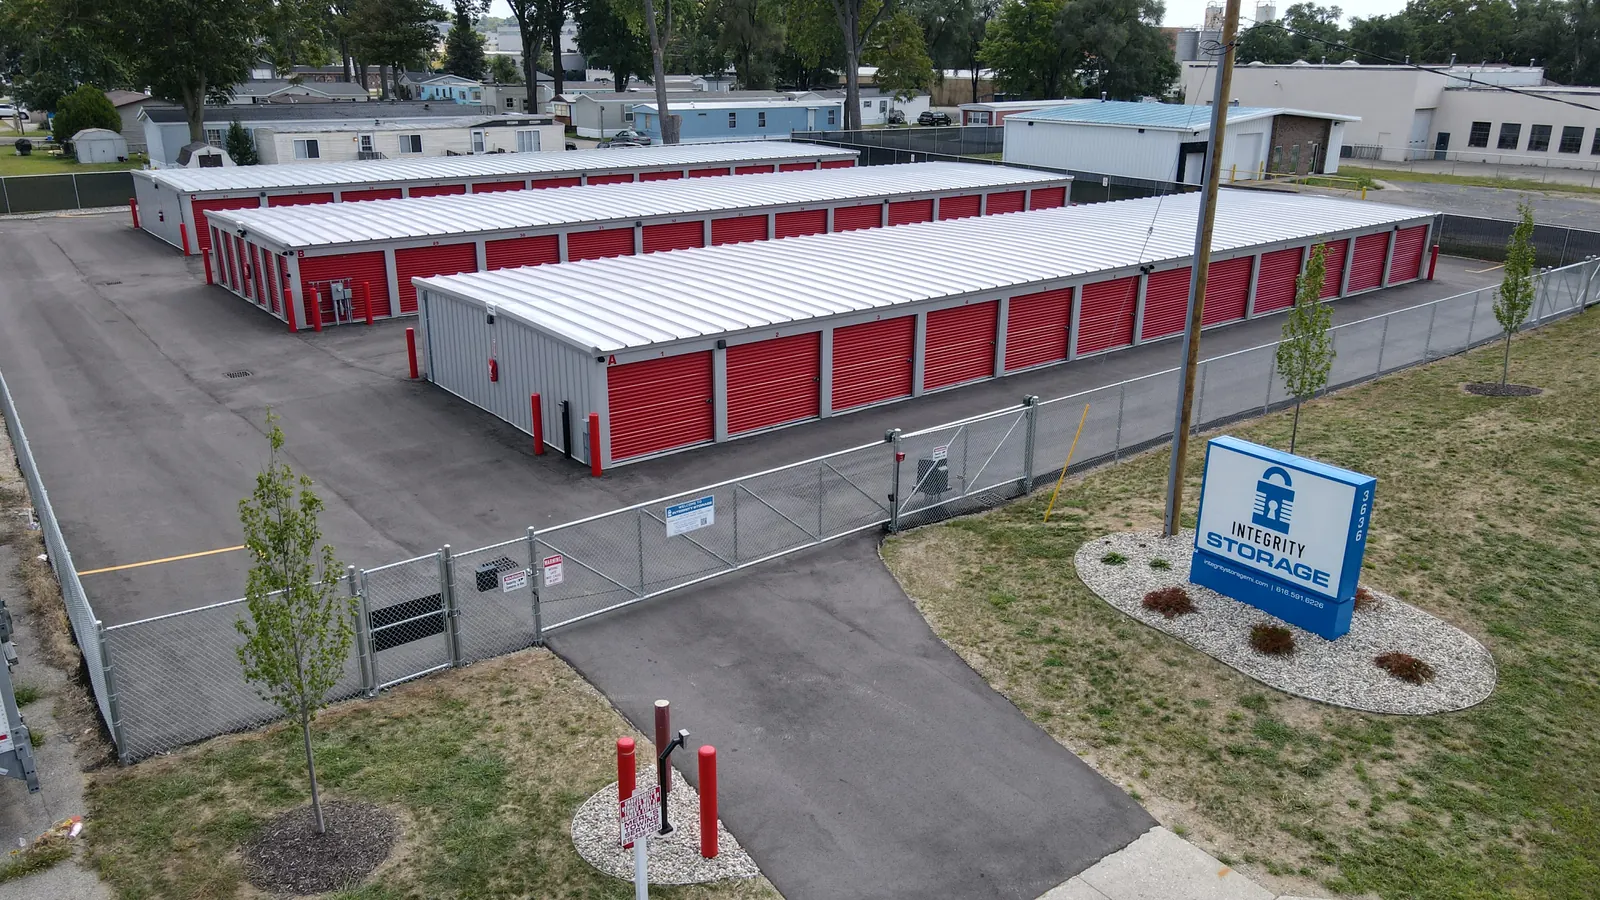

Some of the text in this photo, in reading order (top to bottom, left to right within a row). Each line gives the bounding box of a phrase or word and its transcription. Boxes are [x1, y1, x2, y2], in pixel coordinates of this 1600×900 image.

[297, 249, 305, 257] B
[607, 354, 617, 365] A
[1355, 489, 1369, 542] 3636
[1231, 521, 1306, 559] INTEGRITY
[544, 556, 562, 565] WARNING
[1206, 531, 1331, 588] STORAGE
[1203, 559, 1324, 609] integritystoragemi.com 616.591.6226
[624, 814, 659, 832] TOWING
[624, 819, 659, 838] SERVICE
